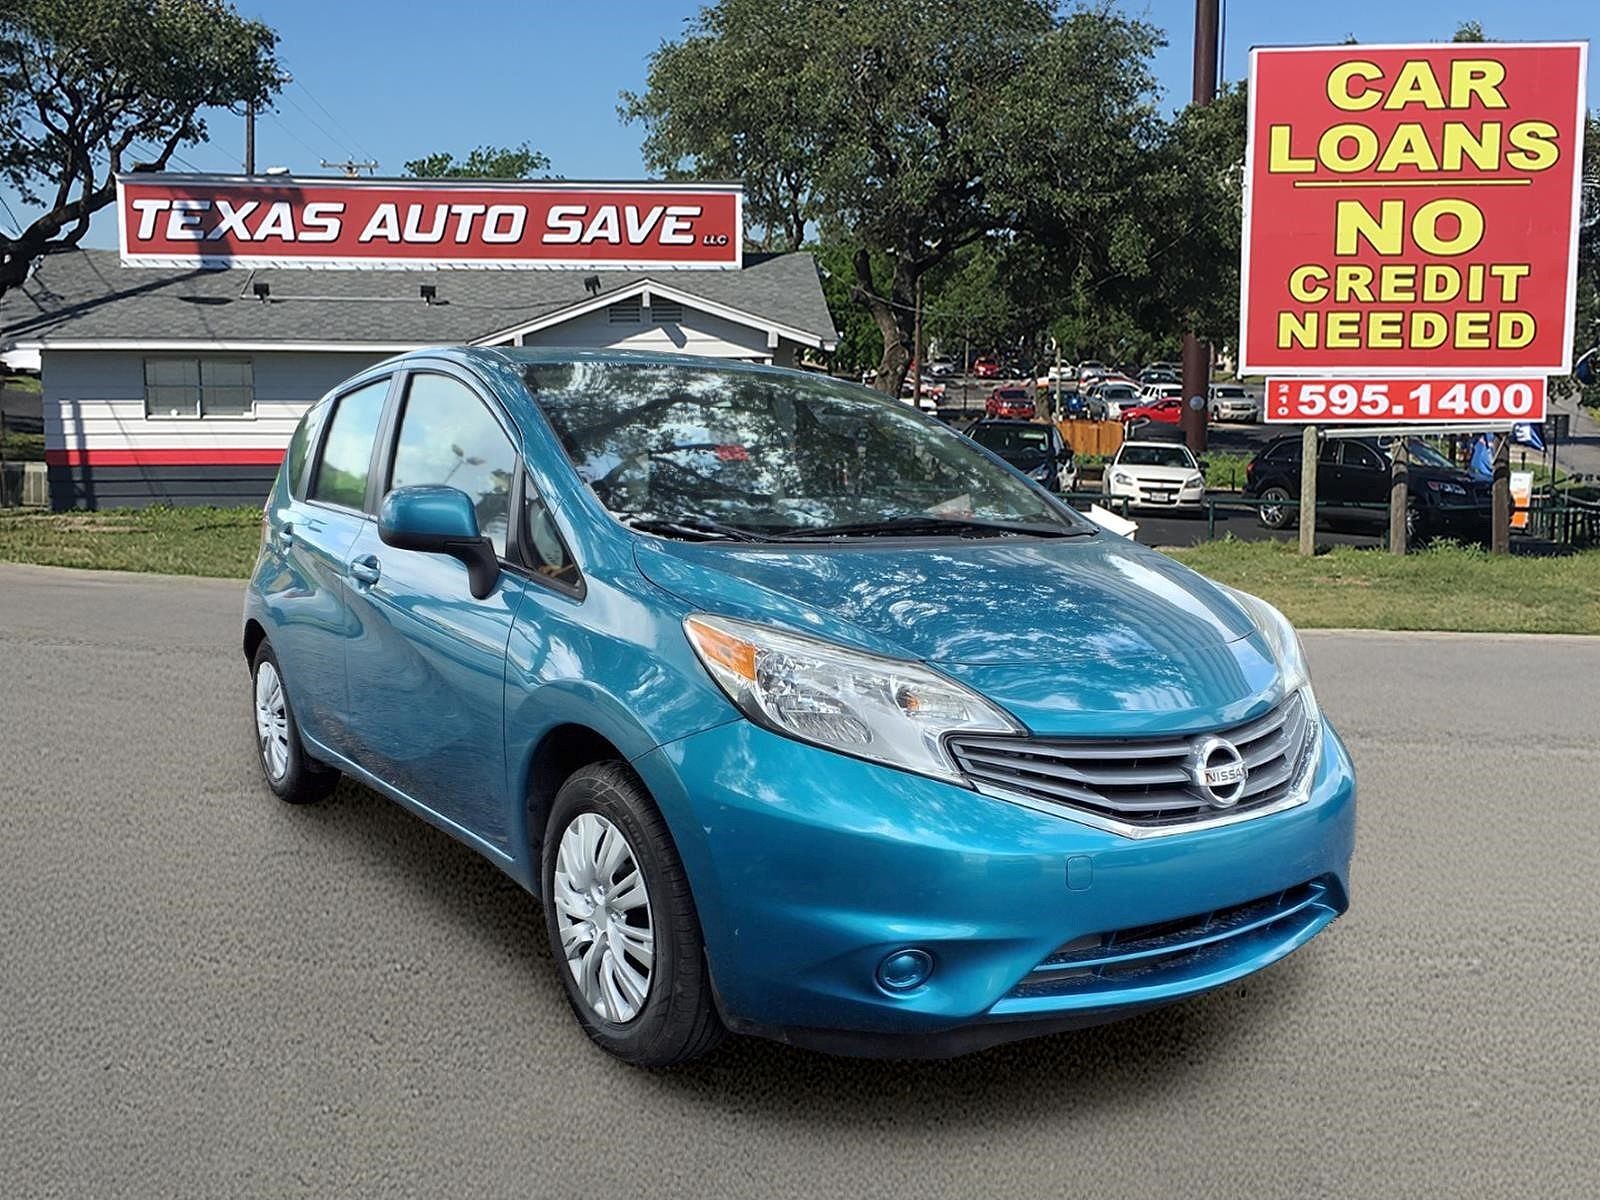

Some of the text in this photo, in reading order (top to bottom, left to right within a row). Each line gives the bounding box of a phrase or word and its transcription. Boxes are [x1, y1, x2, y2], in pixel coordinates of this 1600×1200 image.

[1326, 59, 1509, 111] CAR
[1268, 120, 1560, 173] LOANS
[132, 199, 729, 246] TEXAS AUTO SAVE LLC
[1335, 197, 1486, 256] NO
[1288, 264, 1531, 303] CREDIT
[1277, 310, 1537, 350] NEEDED
[1297, 383, 1533, 416] 595.1400
